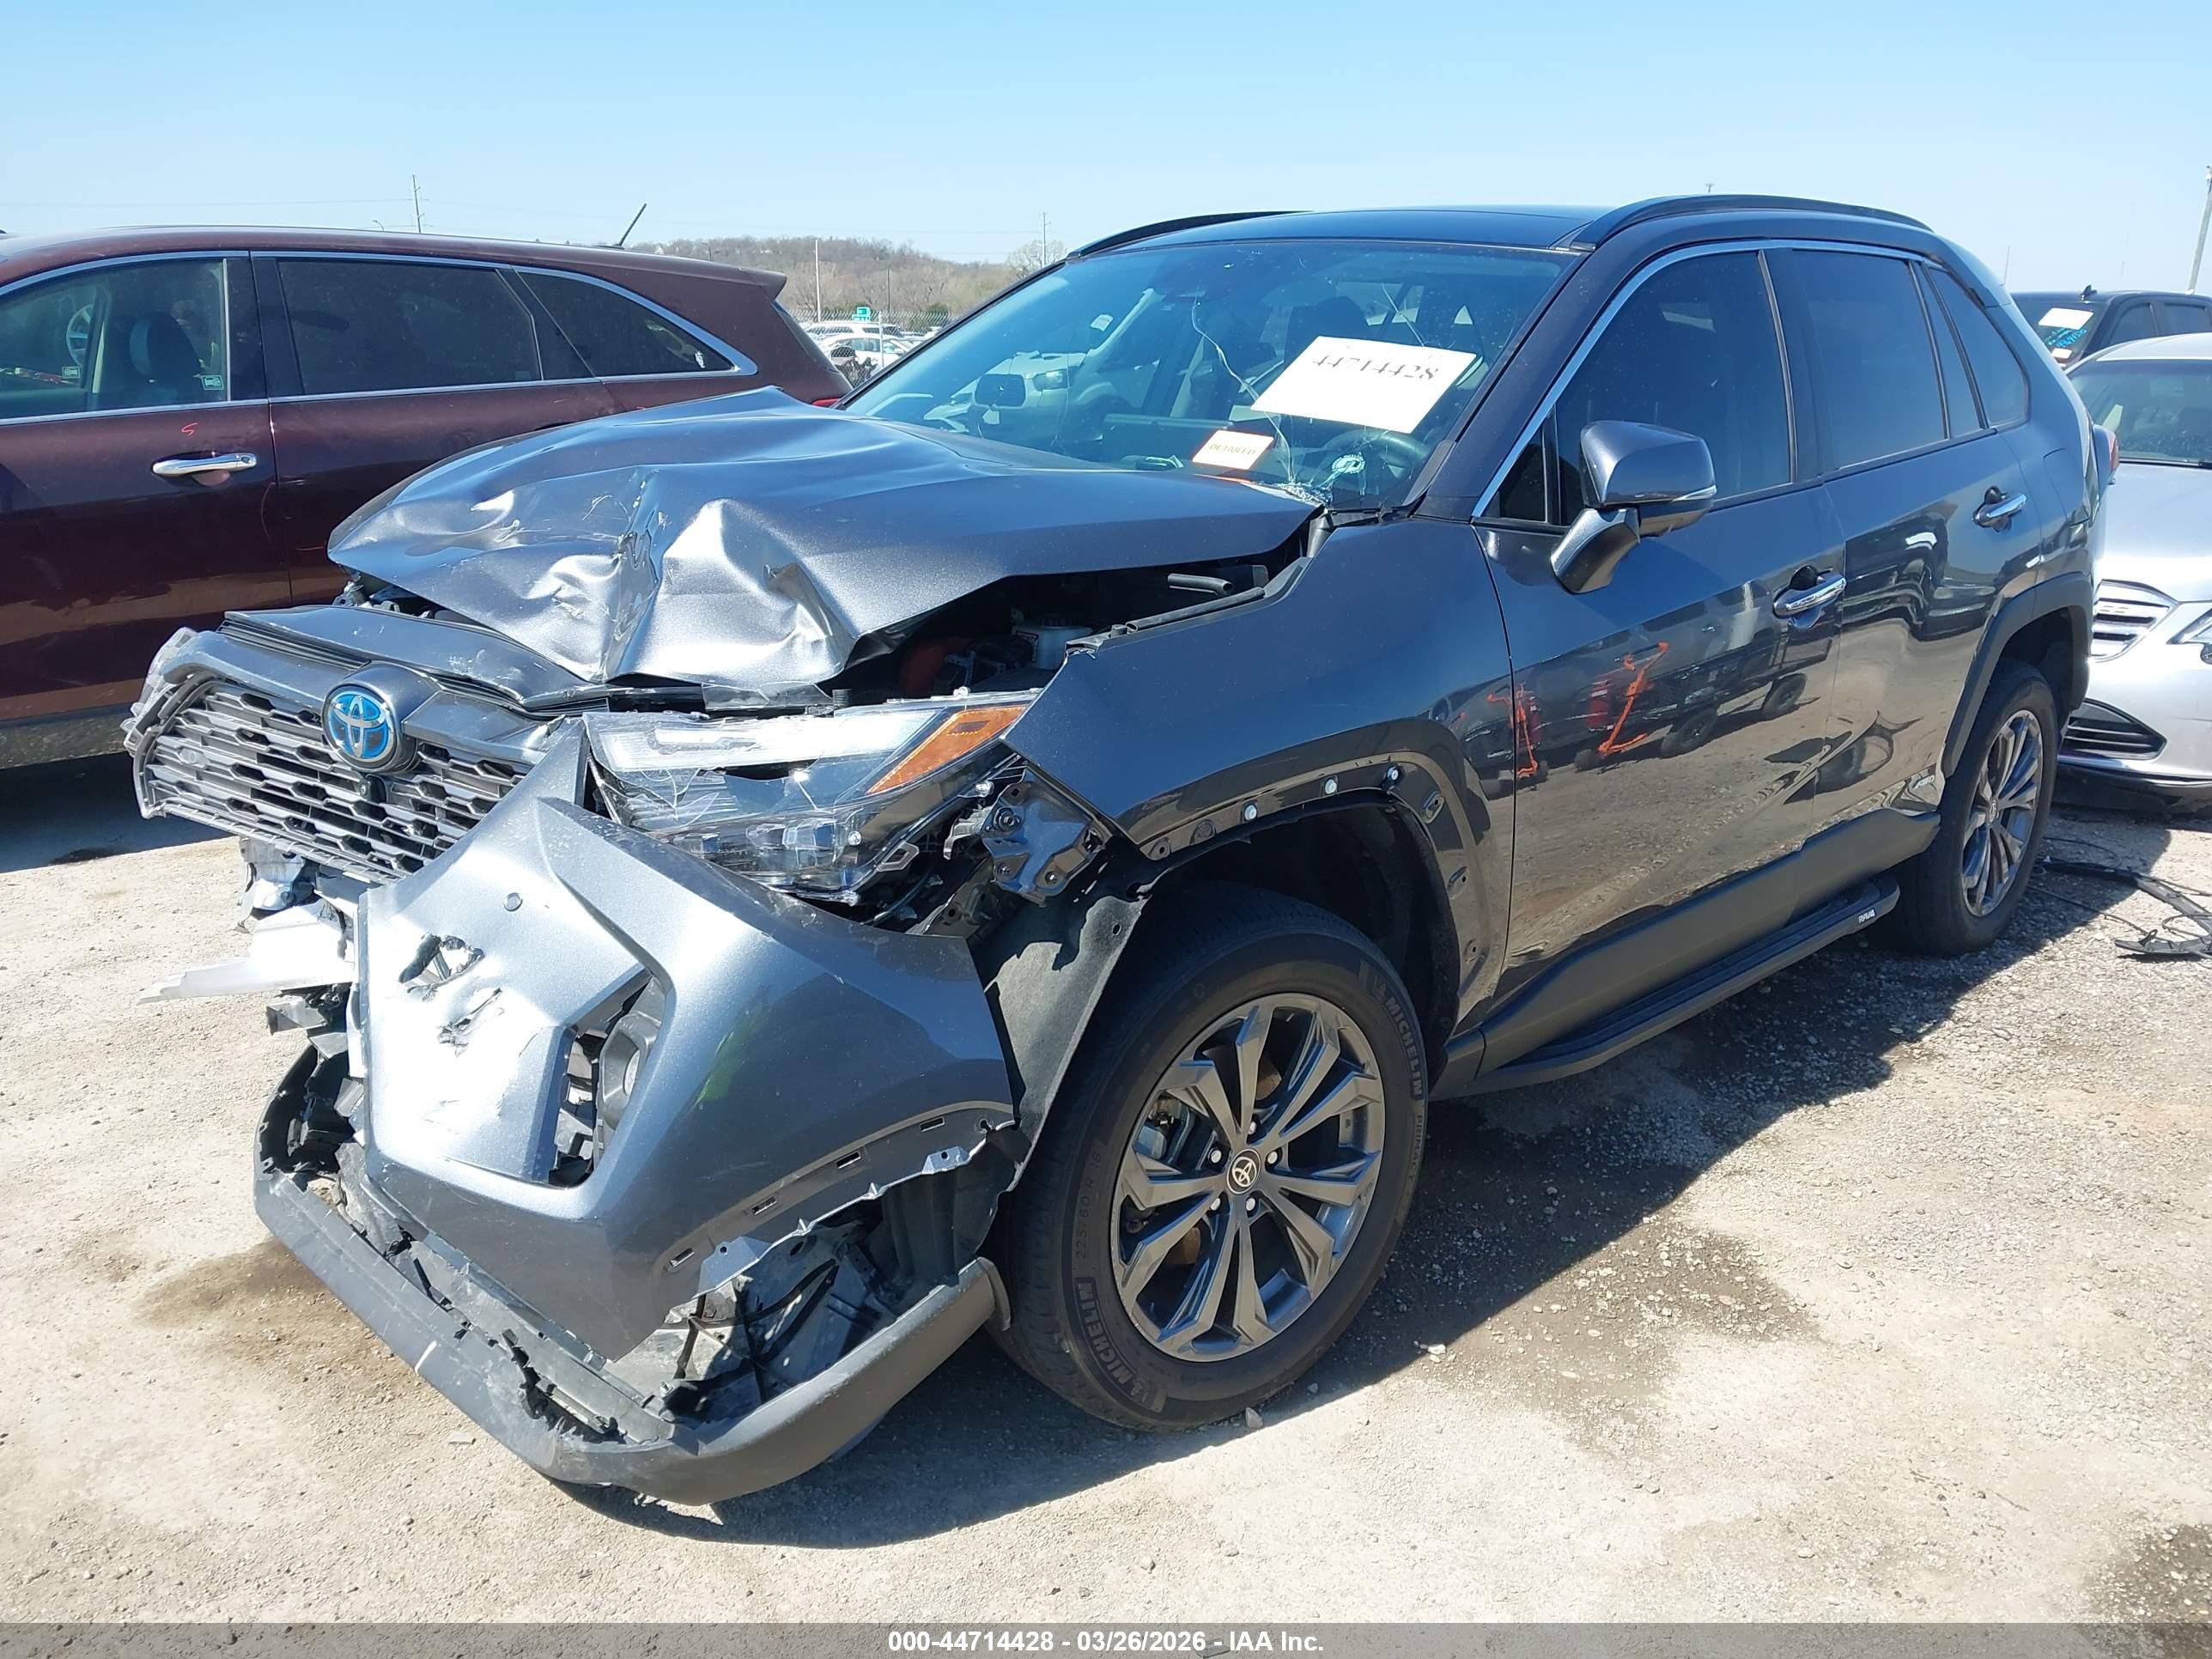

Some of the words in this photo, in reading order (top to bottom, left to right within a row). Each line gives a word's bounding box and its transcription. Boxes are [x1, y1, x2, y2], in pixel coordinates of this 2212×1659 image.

[1312, 355, 1438, 380] 44714428
[1858, 908, 1875, 924] RAV4
[1384, 995, 1424, 1096] MICHELIN
[1078, 1282, 1133, 1385] MICHELIN
